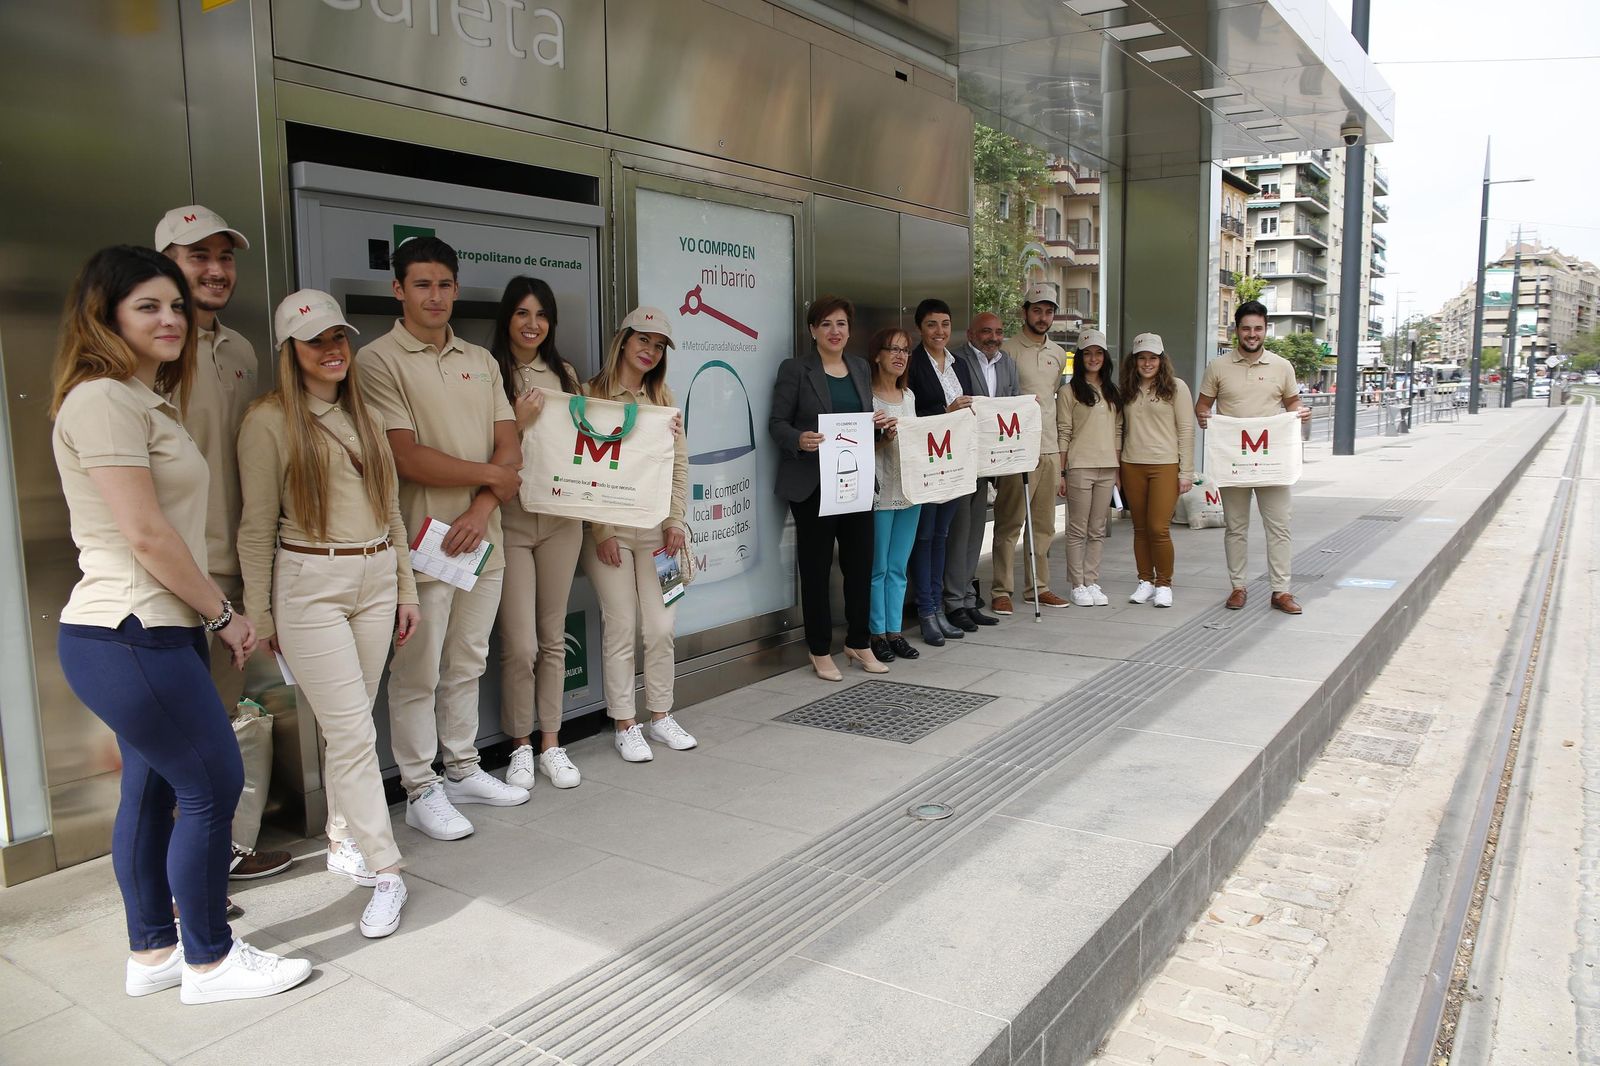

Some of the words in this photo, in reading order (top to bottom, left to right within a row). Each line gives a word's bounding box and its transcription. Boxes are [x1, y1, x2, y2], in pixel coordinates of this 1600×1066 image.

[322, 0, 565, 69] eta
[456, 249, 522, 264] tropolitano
[524, 255, 537, 266] de
[540, 256, 582, 270] Granada
[679, 236, 696, 253] YO
[698, 239, 741, 258] COMPRO
[743, 245, 755, 260] EN
[701, 264, 718, 285] mi
[720, 264, 756, 289] barrio
[682, 341, 757, 352] #MetroGranadaNosAcerca
[997, 412, 1020, 441] M
[573, 422, 623, 470] M
[928, 429, 952, 463] M
[1242, 429, 1268, 455] M
[705, 485, 712, 500] el
[714, 477, 750, 499] comercio
[693, 505, 712, 522] local
[723, 500, 742, 518] todo
[743, 497, 751, 511] lo
[692, 531, 709, 547] que
[712, 520, 751, 541] necesitas.
[564, 666, 583, 678] ALUCIA
